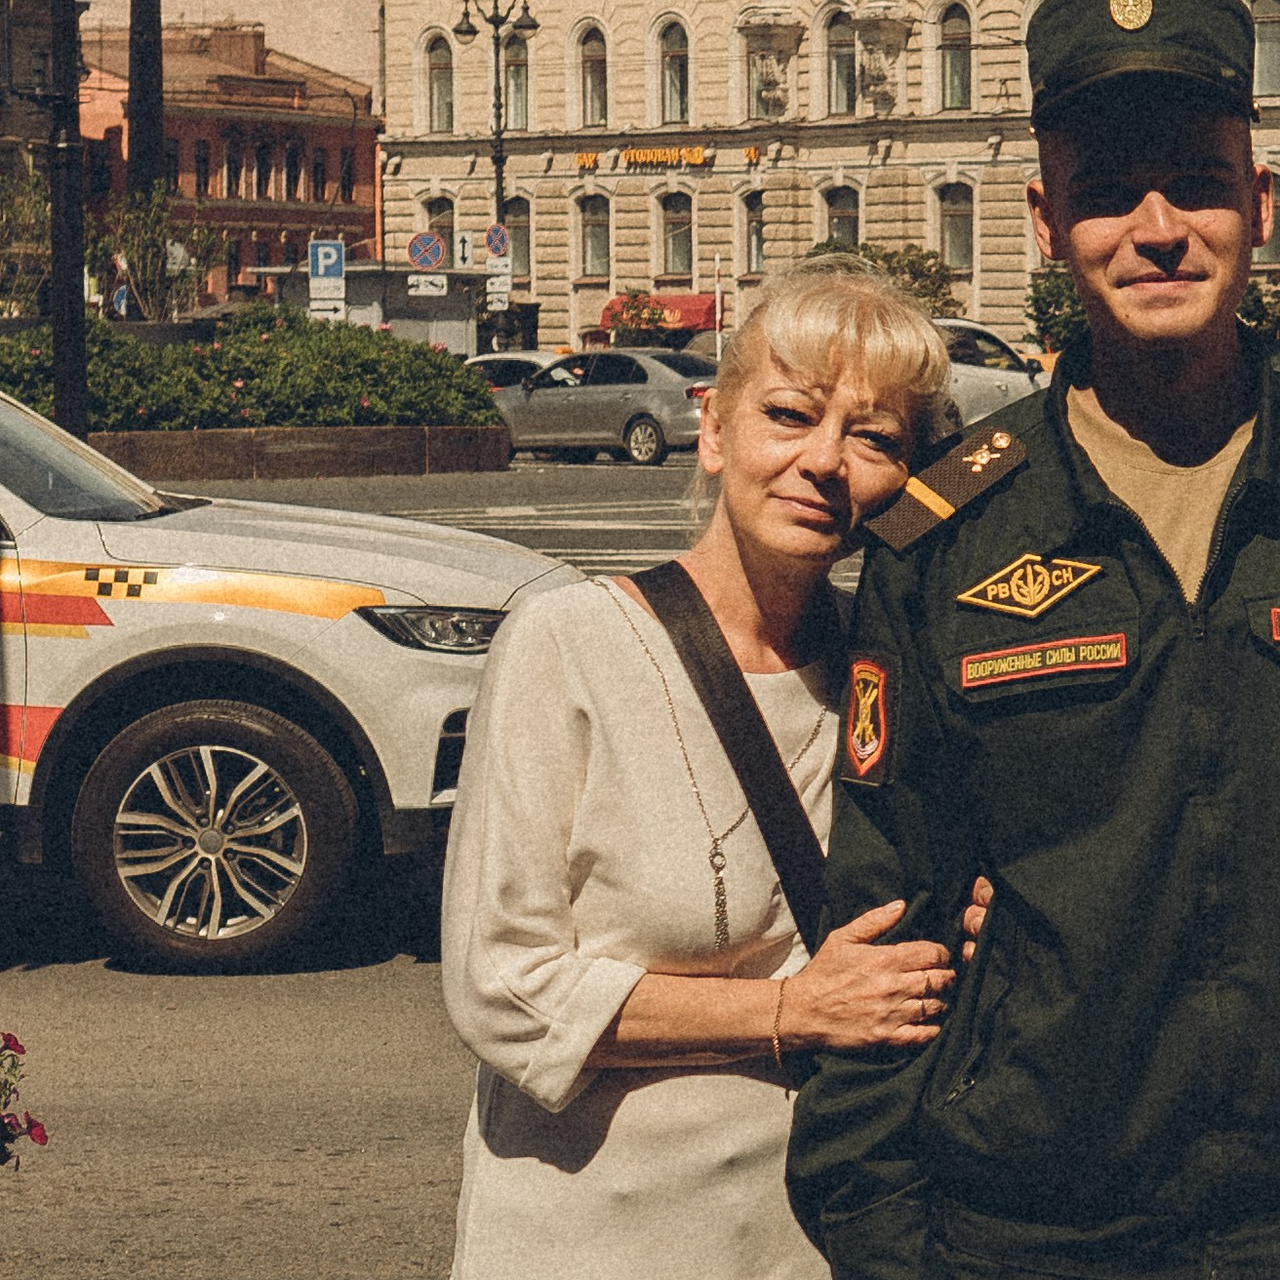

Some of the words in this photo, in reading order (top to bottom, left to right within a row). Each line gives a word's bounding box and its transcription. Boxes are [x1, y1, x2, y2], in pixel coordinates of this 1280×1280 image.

[317, 246, 338, 275] P
[967, 652, 1043, 680] ВООРУЖЕННЫЕ
[1046, 646, 1076, 666] СИЛЫ
[1079, 643, 1122, 662] РОССИИ
